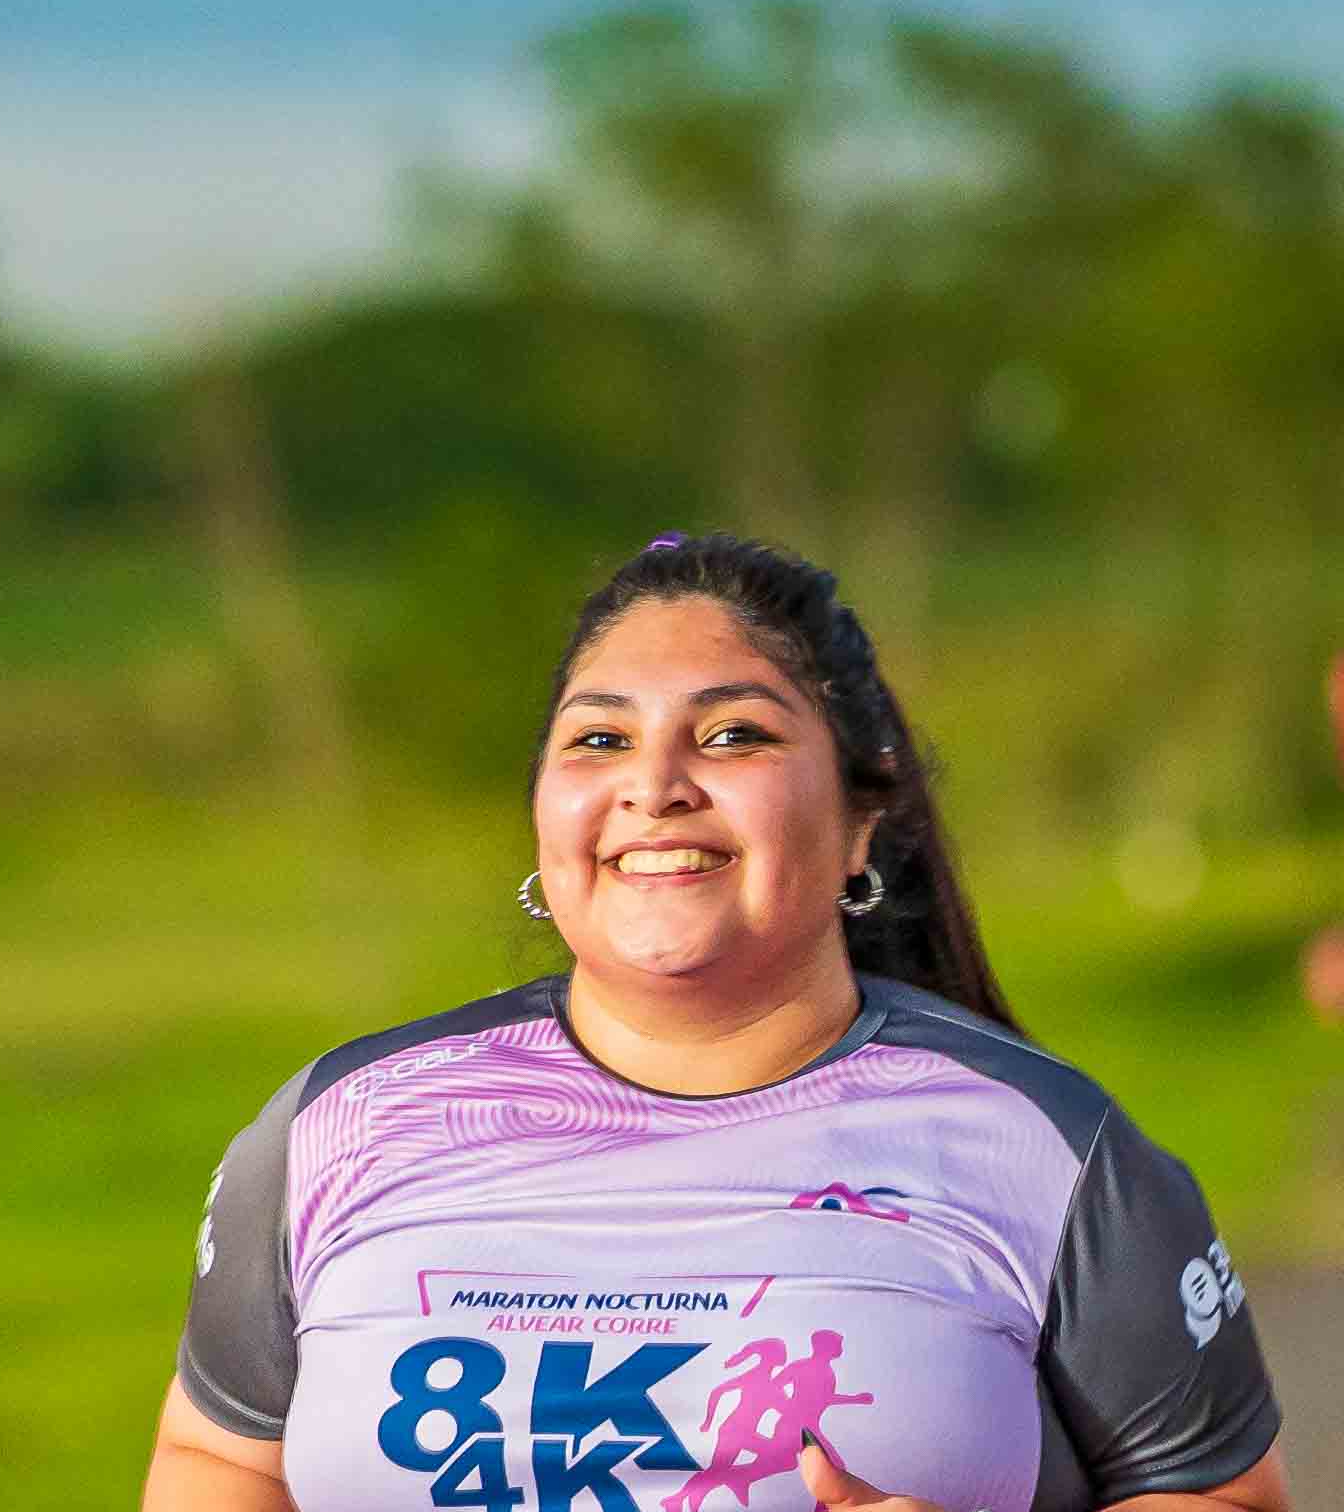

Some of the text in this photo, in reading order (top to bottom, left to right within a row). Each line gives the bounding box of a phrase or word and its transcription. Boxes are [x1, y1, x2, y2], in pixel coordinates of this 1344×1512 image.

[450, 1290, 729, 1311] MARATON NOCTURNA
[487, 1314, 679, 1335] ALVEAR CORRE
[377, 1336, 712, 1472] 8K
